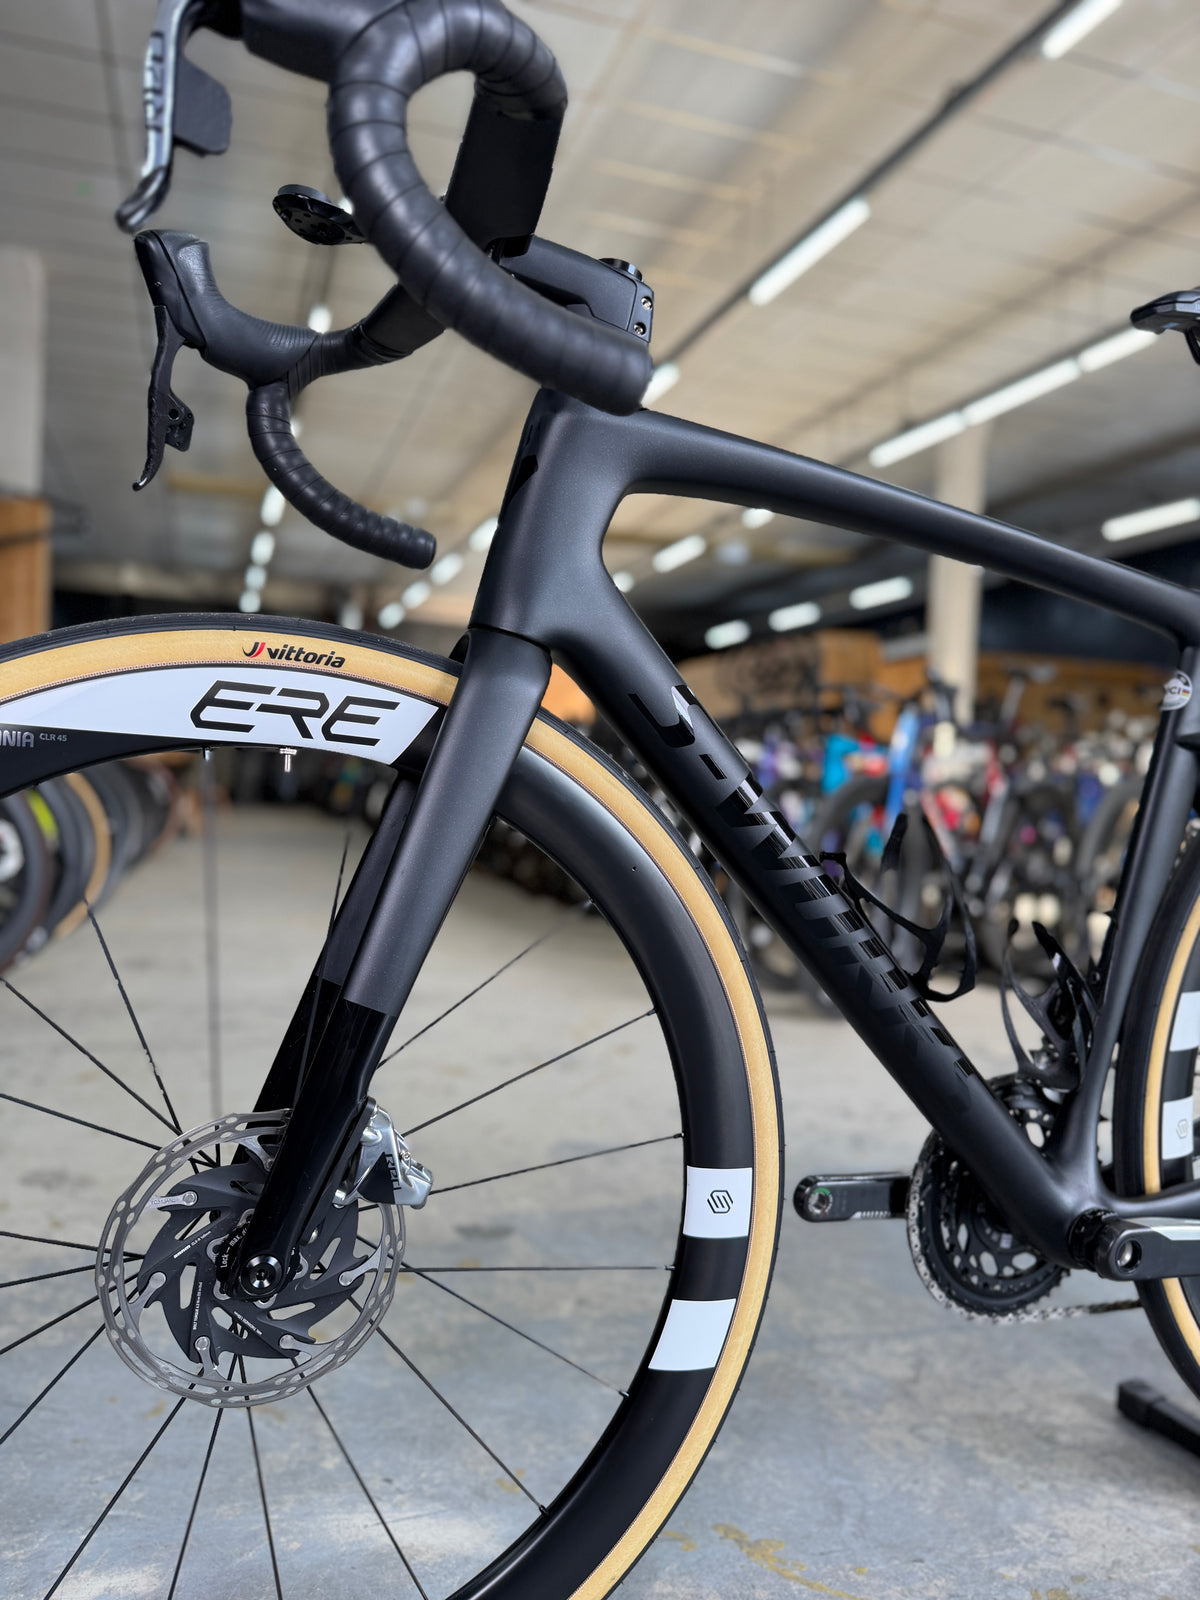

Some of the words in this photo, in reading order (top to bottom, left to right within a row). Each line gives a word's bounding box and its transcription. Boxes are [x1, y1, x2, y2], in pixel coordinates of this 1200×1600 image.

[266, 643, 346, 669] vittoria
[189, 680, 401, 747] ERE
[0, 729, 35, 748] NIA
[39, 732, 56, 741] CLR
[57, 734, 68, 742] 45
[220, 1253, 229, 1268] Lock
